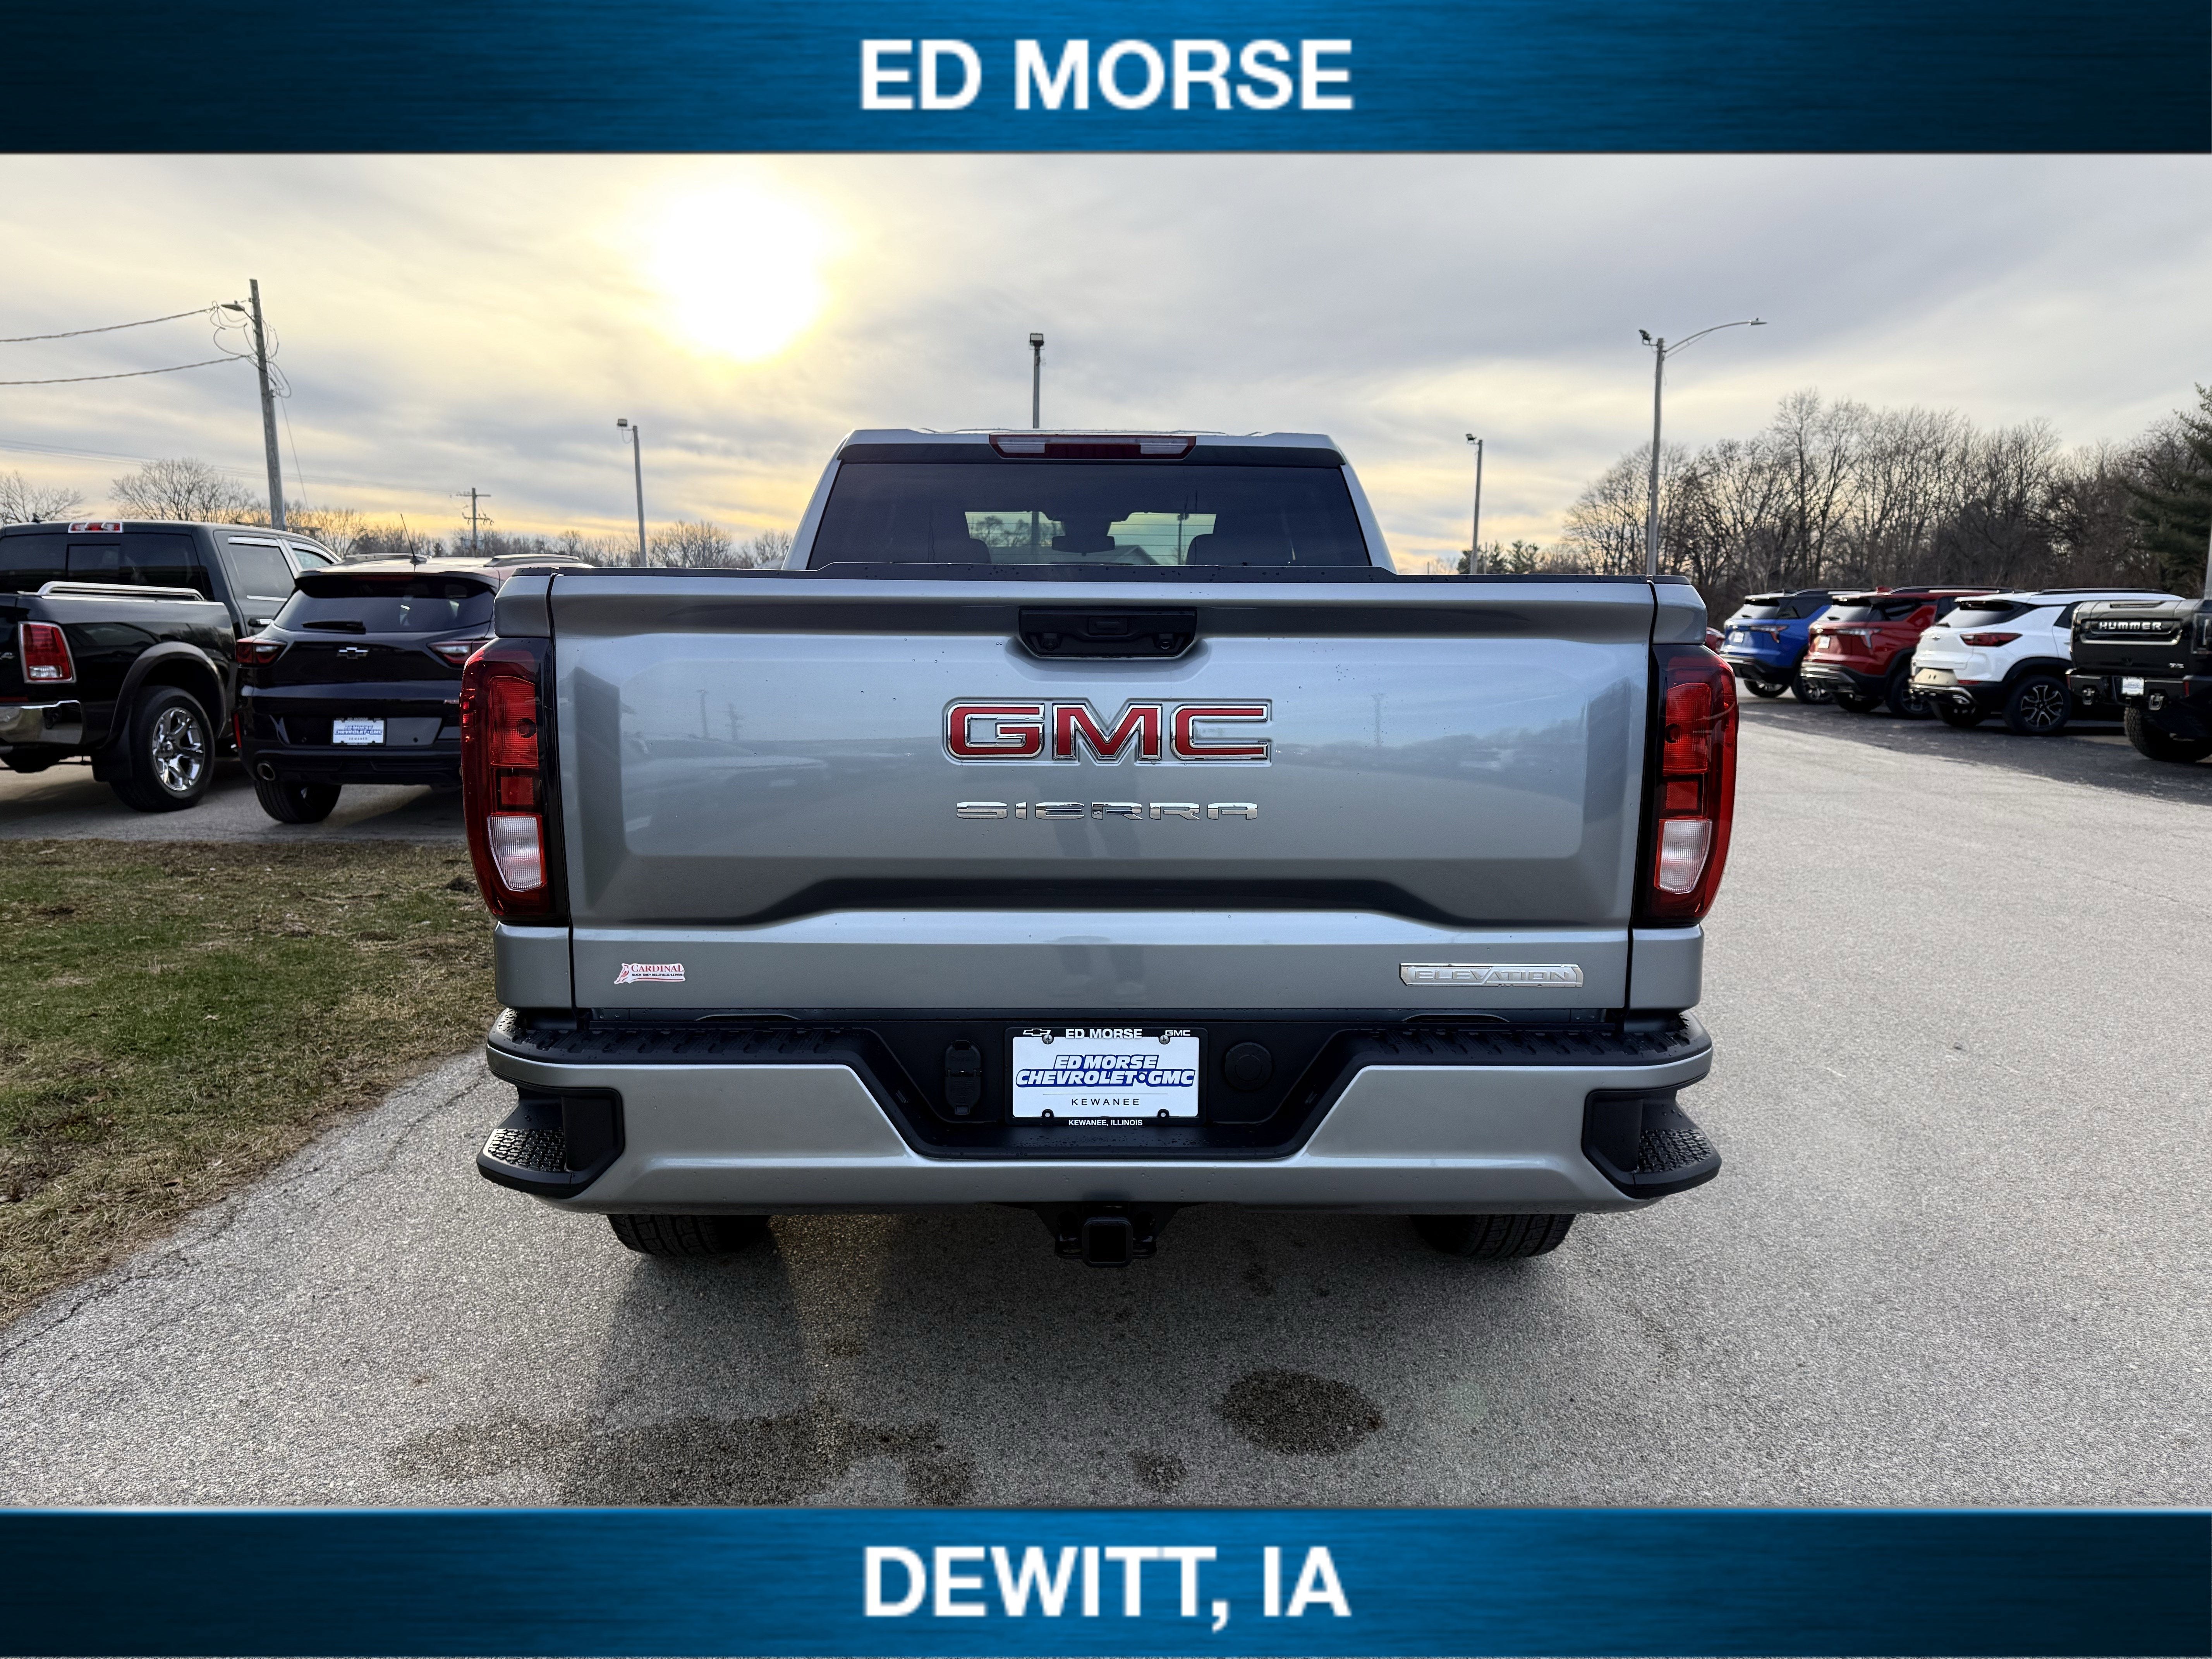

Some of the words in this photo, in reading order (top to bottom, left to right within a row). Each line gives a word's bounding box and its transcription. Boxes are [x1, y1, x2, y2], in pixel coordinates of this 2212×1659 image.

[2099, 622, 2162, 630] HUMMER
[946, 702, 1269, 761] GMC
[956, 801, 1258, 820] SIERRA
[1414, 970, 1569, 981] ELEVATION
[1065, 1029, 1085, 1039] ED
[1089, 1029, 1142, 1039] MORSE
[1054, 1055, 1083, 1069] ED
[1084, 1055, 1159, 1069] MORSE
